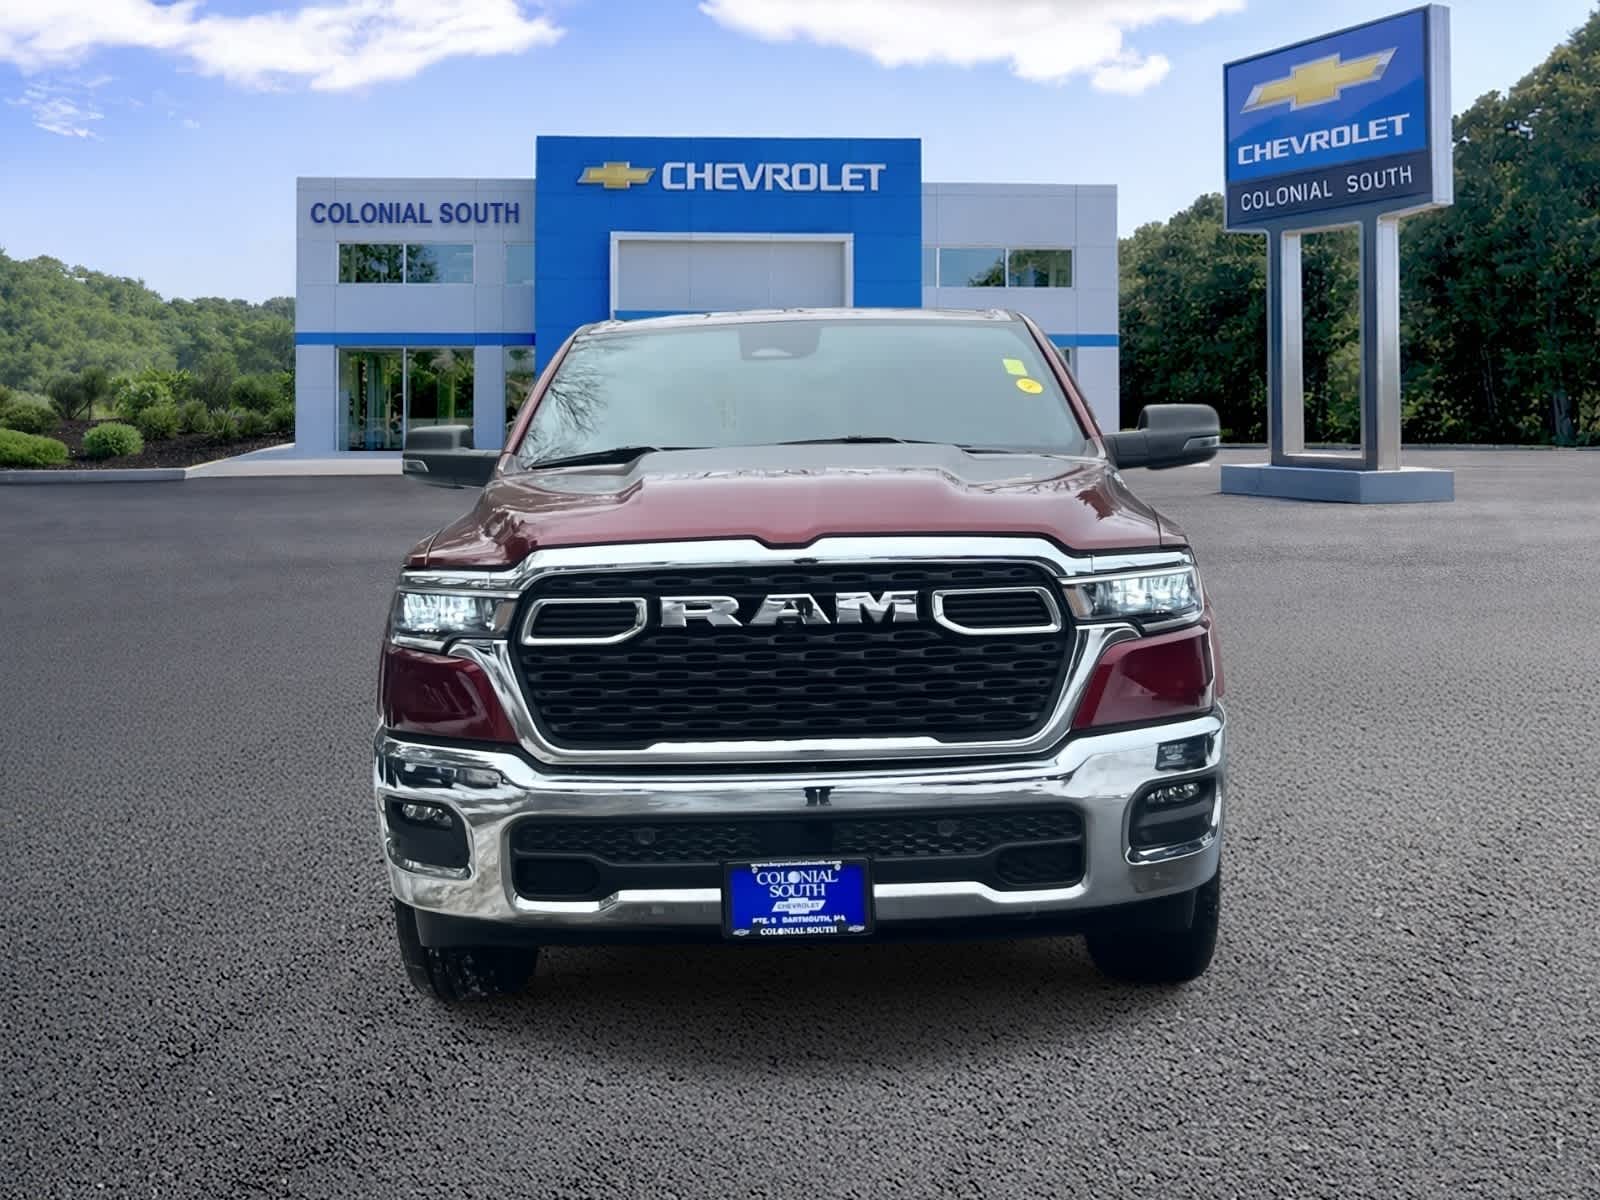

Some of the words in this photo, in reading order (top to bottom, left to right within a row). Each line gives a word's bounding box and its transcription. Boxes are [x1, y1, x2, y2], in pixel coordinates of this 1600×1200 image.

[1237, 113, 1410, 165] CHEVROLET
[662, 162, 886, 192] CHEVROLET
[1240, 179, 1332, 211] COLONIAL
[1346, 164, 1413, 193] SOUTH
[310, 202, 432, 224] COLONIAL
[440, 202, 520, 224] SOUTH
[660, 590, 919, 627] RAM
[756, 869, 839, 885] COLONIAL
[769, 883, 826, 898] SOUTH
[777, 902, 820, 910] CHEVROLET
[760, 927, 806, 936] COLONIAL
[807, 926, 838, 934] SOUTH
